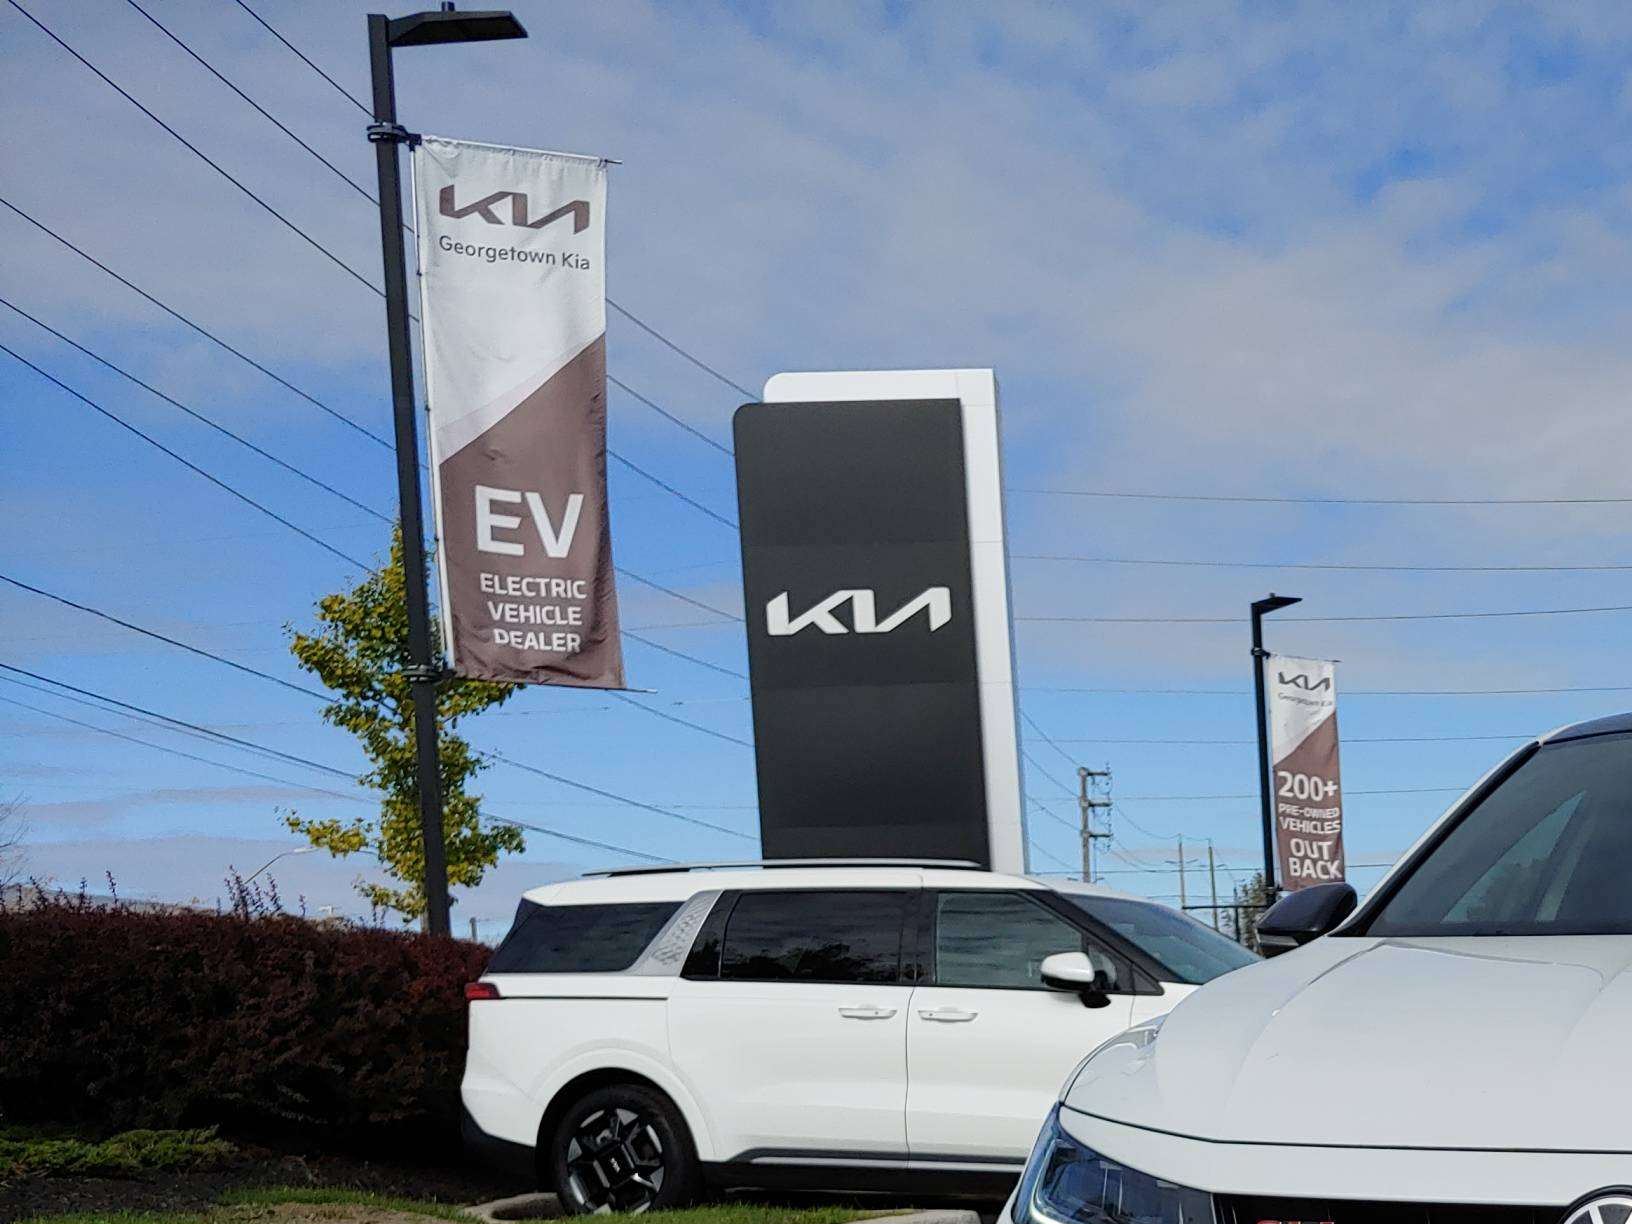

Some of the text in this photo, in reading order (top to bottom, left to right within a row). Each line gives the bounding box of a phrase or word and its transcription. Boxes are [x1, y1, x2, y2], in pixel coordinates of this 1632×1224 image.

[439, 184, 590, 235] KIA
[439, 235, 590, 270] Georgetown Kia
[475, 484, 584, 558] EV
[480, 573, 587, 599] ELECTRIC
[487, 601, 582, 625] VEHICLE
[766, 586, 952, 635] KIA
[493, 628, 581, 652] DEALER
[1278, 671, 1331, 692] KIA
[1278, 770, 1338, 801] 200+
[1278, 803, 1340, 818] PRE-OWNED
[1279, 817, 1341, 834] VEHICLES
[1290, 838, 1333, 860] OUT
[1289, 857, 1342, 880] BACK
